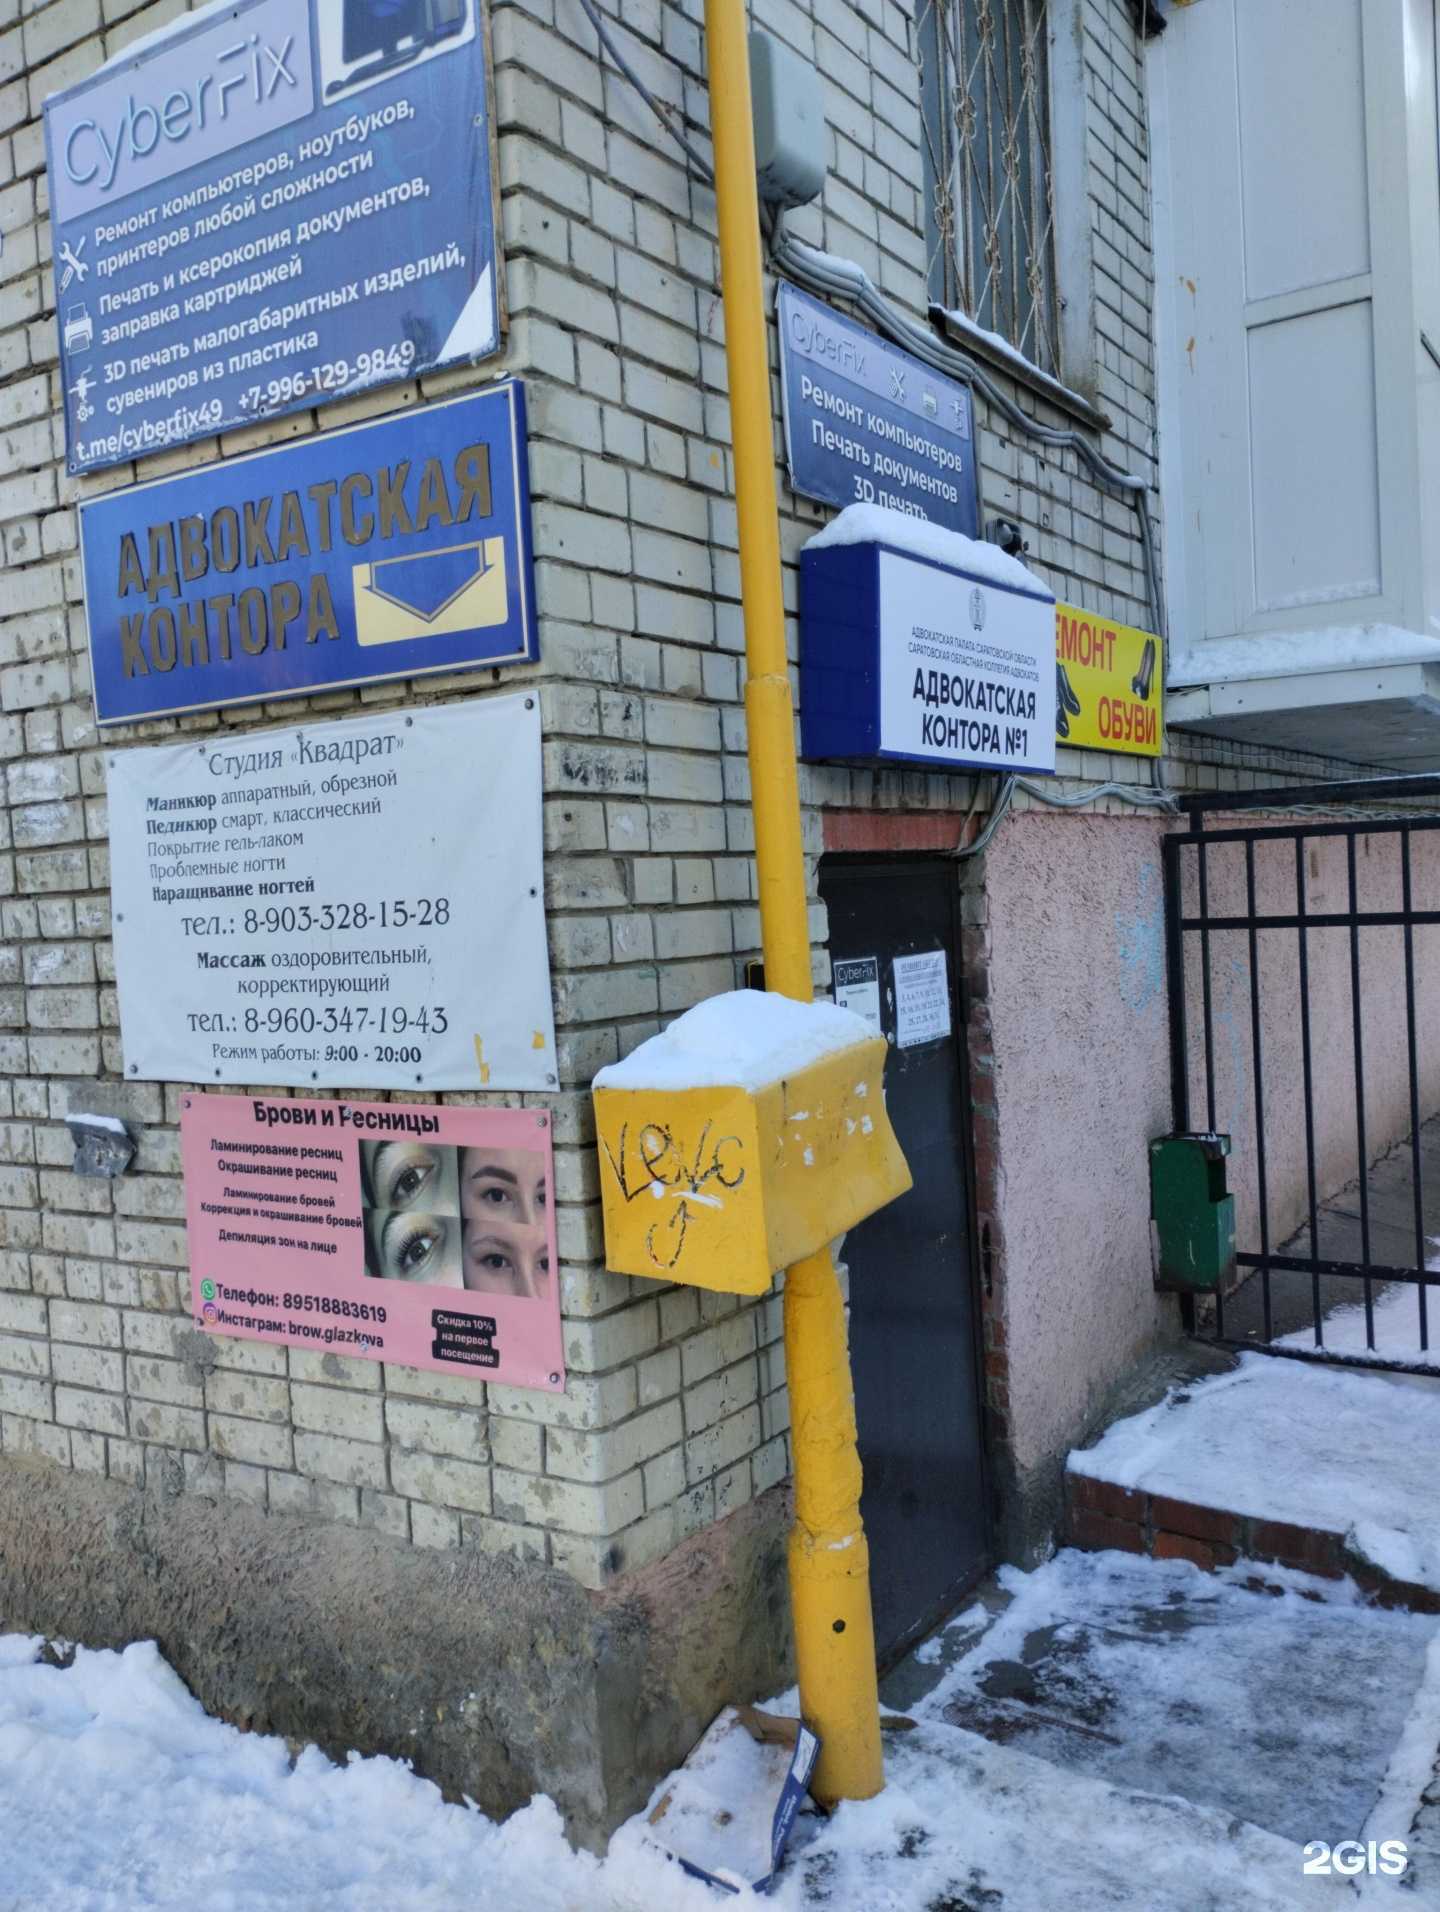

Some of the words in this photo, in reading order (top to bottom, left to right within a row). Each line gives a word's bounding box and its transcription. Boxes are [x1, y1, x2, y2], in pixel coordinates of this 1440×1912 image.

[65, 34, 296, 190] CyberFix
[95, 207, 157, 246] Ремонт
[162, 151, 294, 219] компьютеров,
[299, 99, 415, 162] ноутбуков,
[97, 226, 190, 277] принтеров
[194, 194, 256, 239] любой
[261, 150, 373, 210] сложности
[100, 282, 159, 315] Печать
[163, 275, 175, 291] и
[179, 228, 291, 285] ксерокопия
[297, 177, 430, 244] документов,
[102, 303, 180, 345] заправка
[184, 254, 302, 315] картриджей
[104, 361, 126, 384] 3D
[131, 342, 189, 375] печать
[194, 281, 359, 353] малогабаритных
[364, 242, 466, 295] изделий,
[106, 370, 198, 415] сувениров
[203, 362, 224, 382] из
[229, 330, 318, 374] пластика
[76, 398, 223, 462] t.me/cyberfix49
[238, 340, 415, 410] +7-996-129-9849
[801, 375, 863, 425] Ремонт
[867, 411, 963, 473] компьютеров
[812, 419, 870, 466] Печать
[874, 452, 958, 504] документов
[853, 475, 875, 503] 3D
[879, 490, 929, 522] печать
[117, 443, 494, 603] АДВОКАТСКАЯ
[120, 573, 341, 679] КОНТОРА
[912, 667, 1036, 720] АДВОКАТСКАЯ
[922, 713, 1000, 754] КОНТОРА
[1005, 727, 1028, 757] №1
[1098, 696, 1157, 745] ОБУВИ
[208, 749, 283, 780] Студия
[290, 735, 404, 766] «Квадрат»
[146, 793, 217, 813] Маникюр
[221, 779, 316, 806] аппаратный,
[321, 769, 398, 796] обрезной
[146, 817, 217, 835] Педикюр
[222, 812, 268, 831] смарт,
[273, 797, 381, 824] классический
[147, 839, 220, 860] Покрытие
[224, 832, 304, 852] гель-лаком
[150, 861, 239, 882] Проблемные
[243, 857, 286, 873] ногти
[152, 883, 253, 905] Наращивание
[259, 876, 315, 896] ногтей
[181, 914, 235, 936] тел.:
[244, 898, 450, 934] 8-903-328-15-28
[197, 952, 266, 969] Массаж
[271, 944, 432, 971] оздоровительный,
[237, 974, 390, 998] корректирующий
[187, 1012, 237, 1033] тел.:
[244, 1006, 448, 1034] 8-960-347-19-43
[212, 1043, 257, 1060] Режим
[261, 1044, 320, 1064] работы:
[324, 1045, 358, 1062] 9:00
[375, 1045, 422, 1063] 20:00
[253, 1101, 317, 1127] Брови
[321, 1109, 335, 1127] и
[338, 1105, 440, 1136] Ресницы
[211, 1138, 299, 1157] Ламинирование
[300, 1148, 344, 1162] ресниц
[217, 1159, 293, 1177] Окрашивание
[295, 1169, 338, 1183] ресниц
[200, 1202, 251, 1216] Коррекция
[260, 1209, 324, 1224] окрашивание
[326, 1214, 363, 1229] бровей
[223, 1187, 298, 1204] Ламинирование
[299, 1194, 336, 1209] бровей
[218, 1229, 276, 1246] Депиляция
[278, 1238, 296, 1248] зон
[297, 1240, 309, 1250] на
[311, 1242, 337, 1255] лице
[216, 1283, 280, 1307] Телефон:
[282, 1292, 387, 1323] 89518883619
[437, 1314, 472, 1328] Скидка
[473, 1319, 494, 1331] 10%
[217, 1309, 286, 1334] Инстаграм:
[289, 1320, 384, 1348] brow.glazkova
[442, 1333, 453, 1342] на
[455, 1335, 489, 1346] первое
[441, 1348, 495, 1363] посещение
